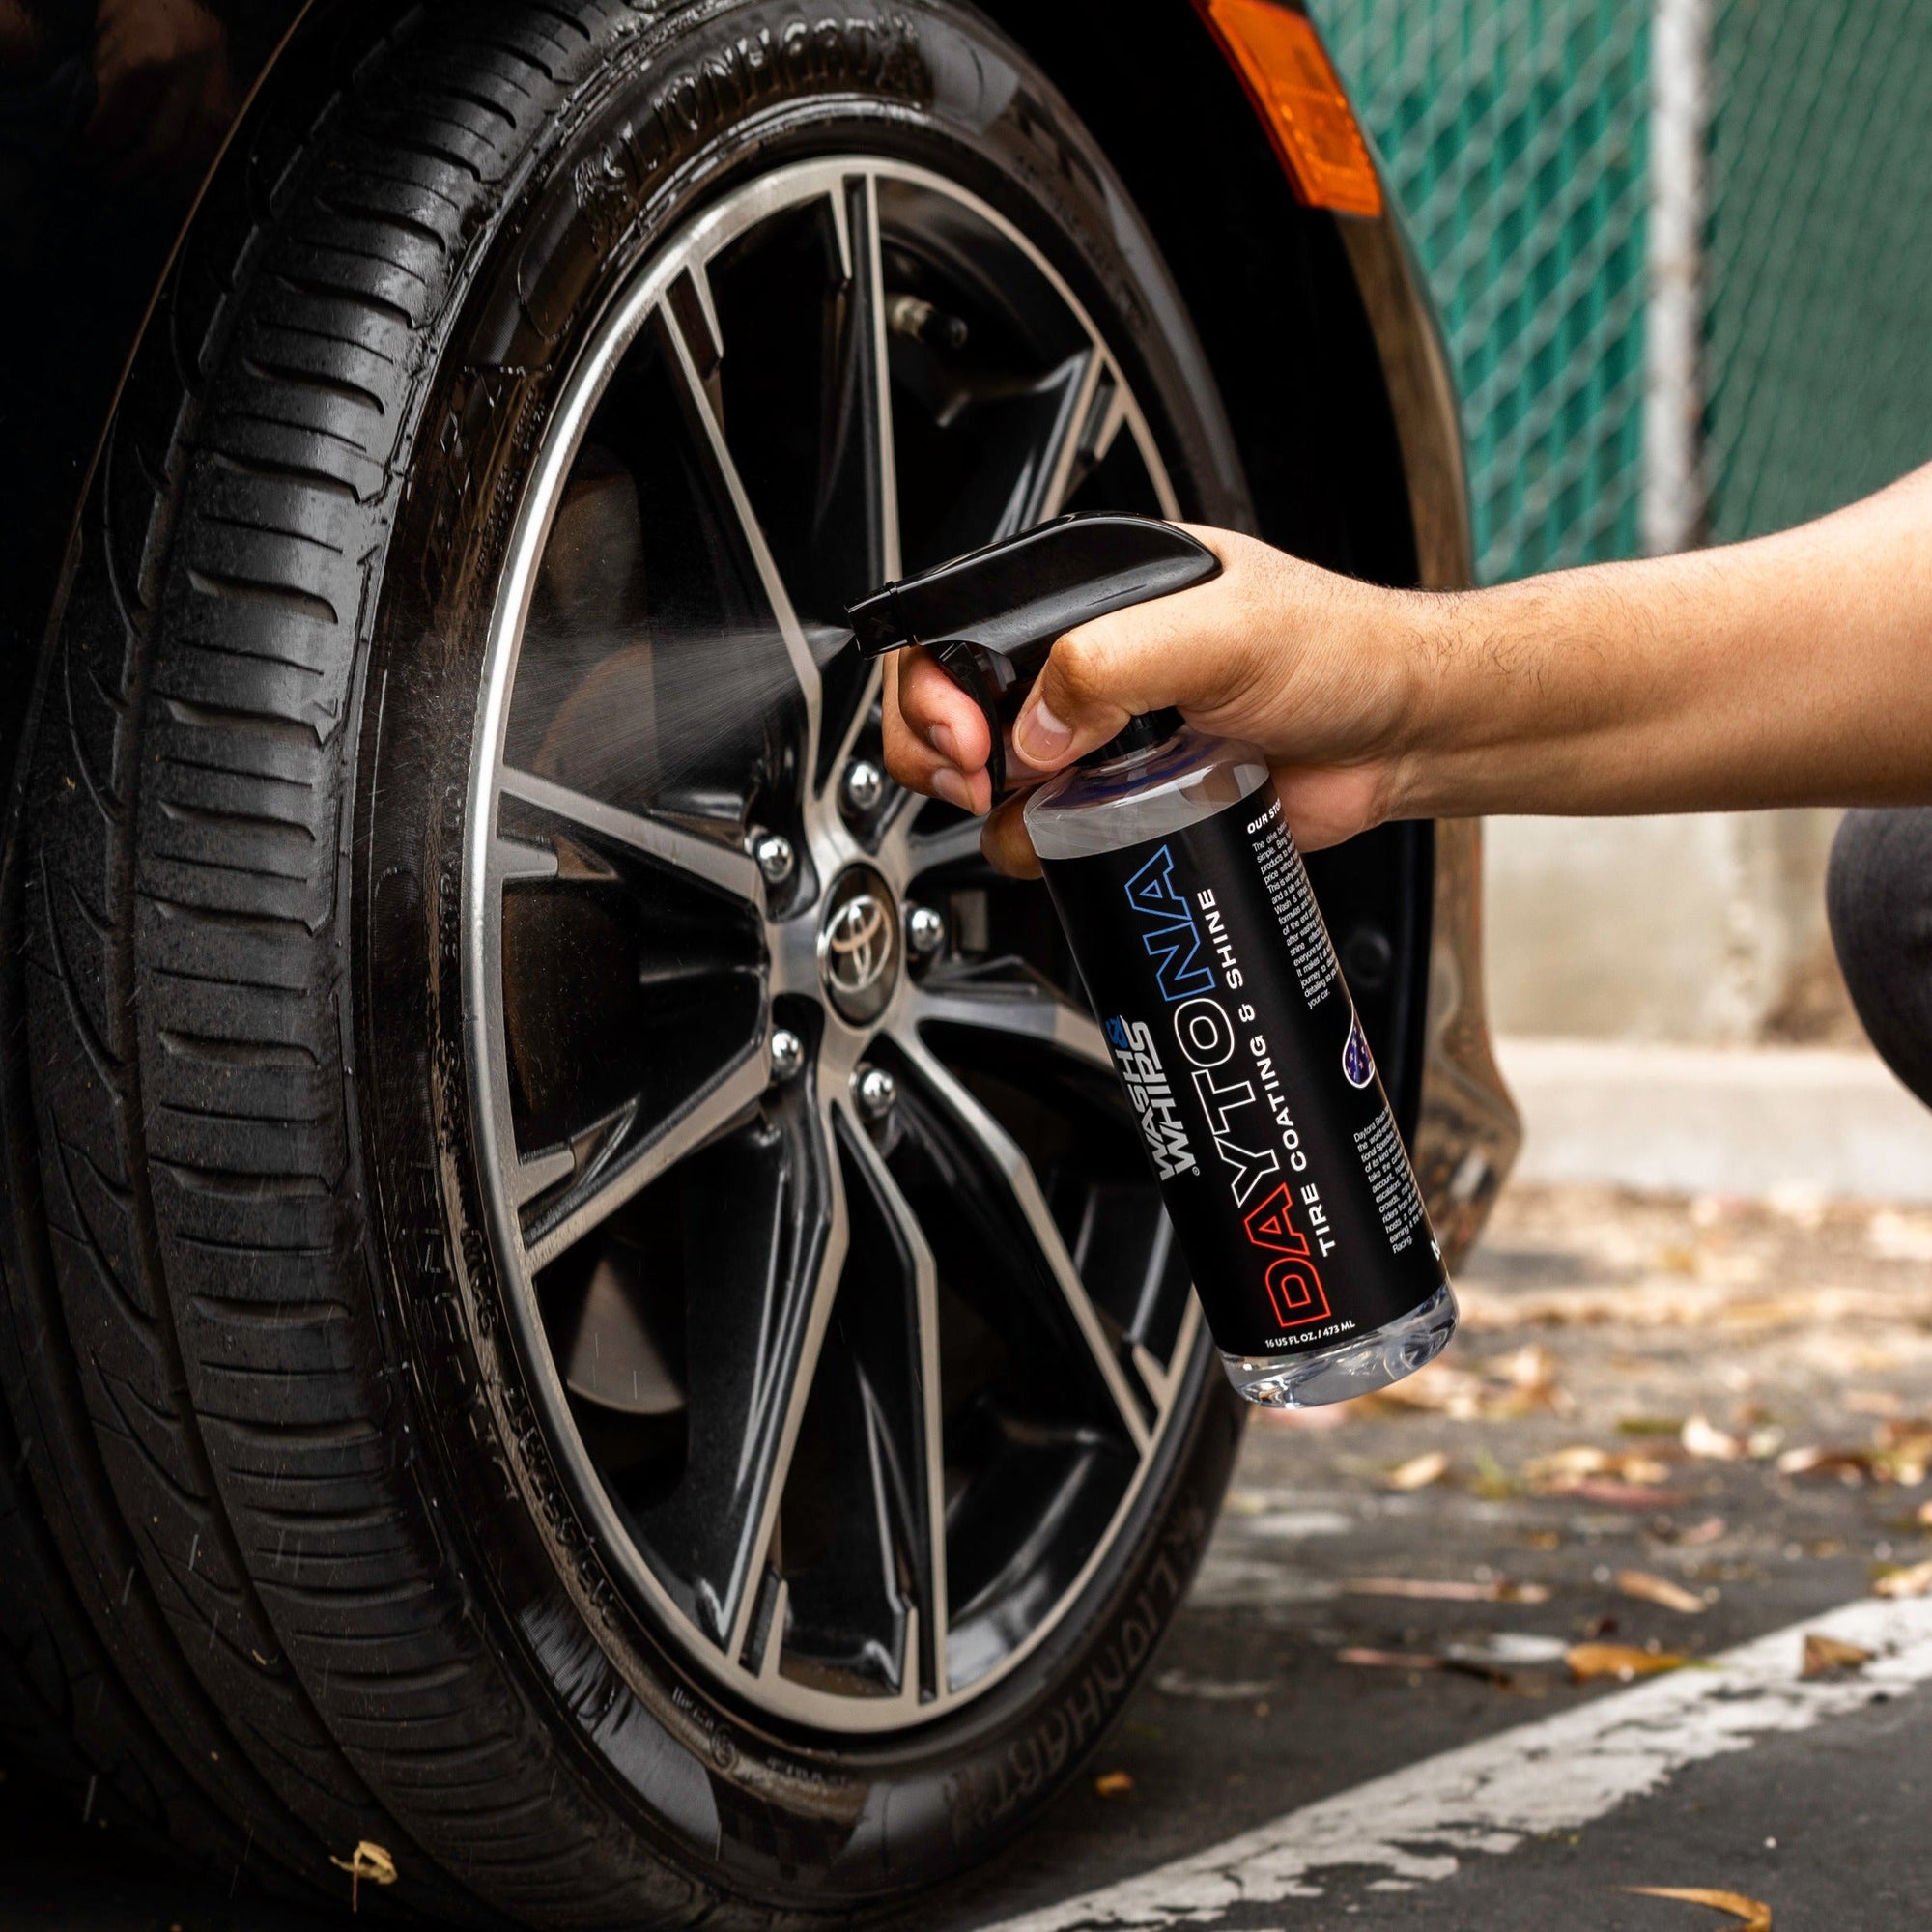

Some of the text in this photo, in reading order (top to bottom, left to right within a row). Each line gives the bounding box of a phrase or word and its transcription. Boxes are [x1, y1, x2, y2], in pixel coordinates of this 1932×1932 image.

[1247, 813, 1268, 834] OUR
[1268, 798, 1281, 819] STO
[1252, 841, 1264, 851] The
[1257, 847, 1275, 863] simple.
[1261, 853, 1283, 875] products
[1264, 870, 1279, 886] price
[1266, 882, 1280, 894] This
[1272, 892, 1284, 904] and
[1274, 899, 1292, 914] Wash
[1293, 895, 1297, 903] &
[1278, 906, 1301, 924] formulas
[1283, 925, 1290, 935] of
[1287, 933, 1298, 946] after
[1290, 943, 1305, 956] shine
[1300, 970, 1320, 989] journey
[1304, 979, 1326, 997] detailing
[1308, 995, 1320, 1009] your
[1197, 888, 1336, 1258] TIRE COATING & SHINE
[1125, 844, 1331, 1328] DAYTONA
[1120, 1015, 1197, 1175] WHIPS
[1353, 1122, 1376, 1142] Daytona
[1357, 1141, 1368, 1152] the
[1365, 1162, 1372, 1173] of
[1368, 1170, 1381, 1183] take
[1385, 1218, 1402, 1234] hosts
[1265, 1339, 1274, 1348] 16
[1275, 1337, 1288, 1347] US
[1288, 1335, 1300, 1345] FL
[1300, 1332, 1317, 1342] OZ.
[1322, 1324, 1339, 1336] 473
[1341, 1320, 1355, 1331] ML
